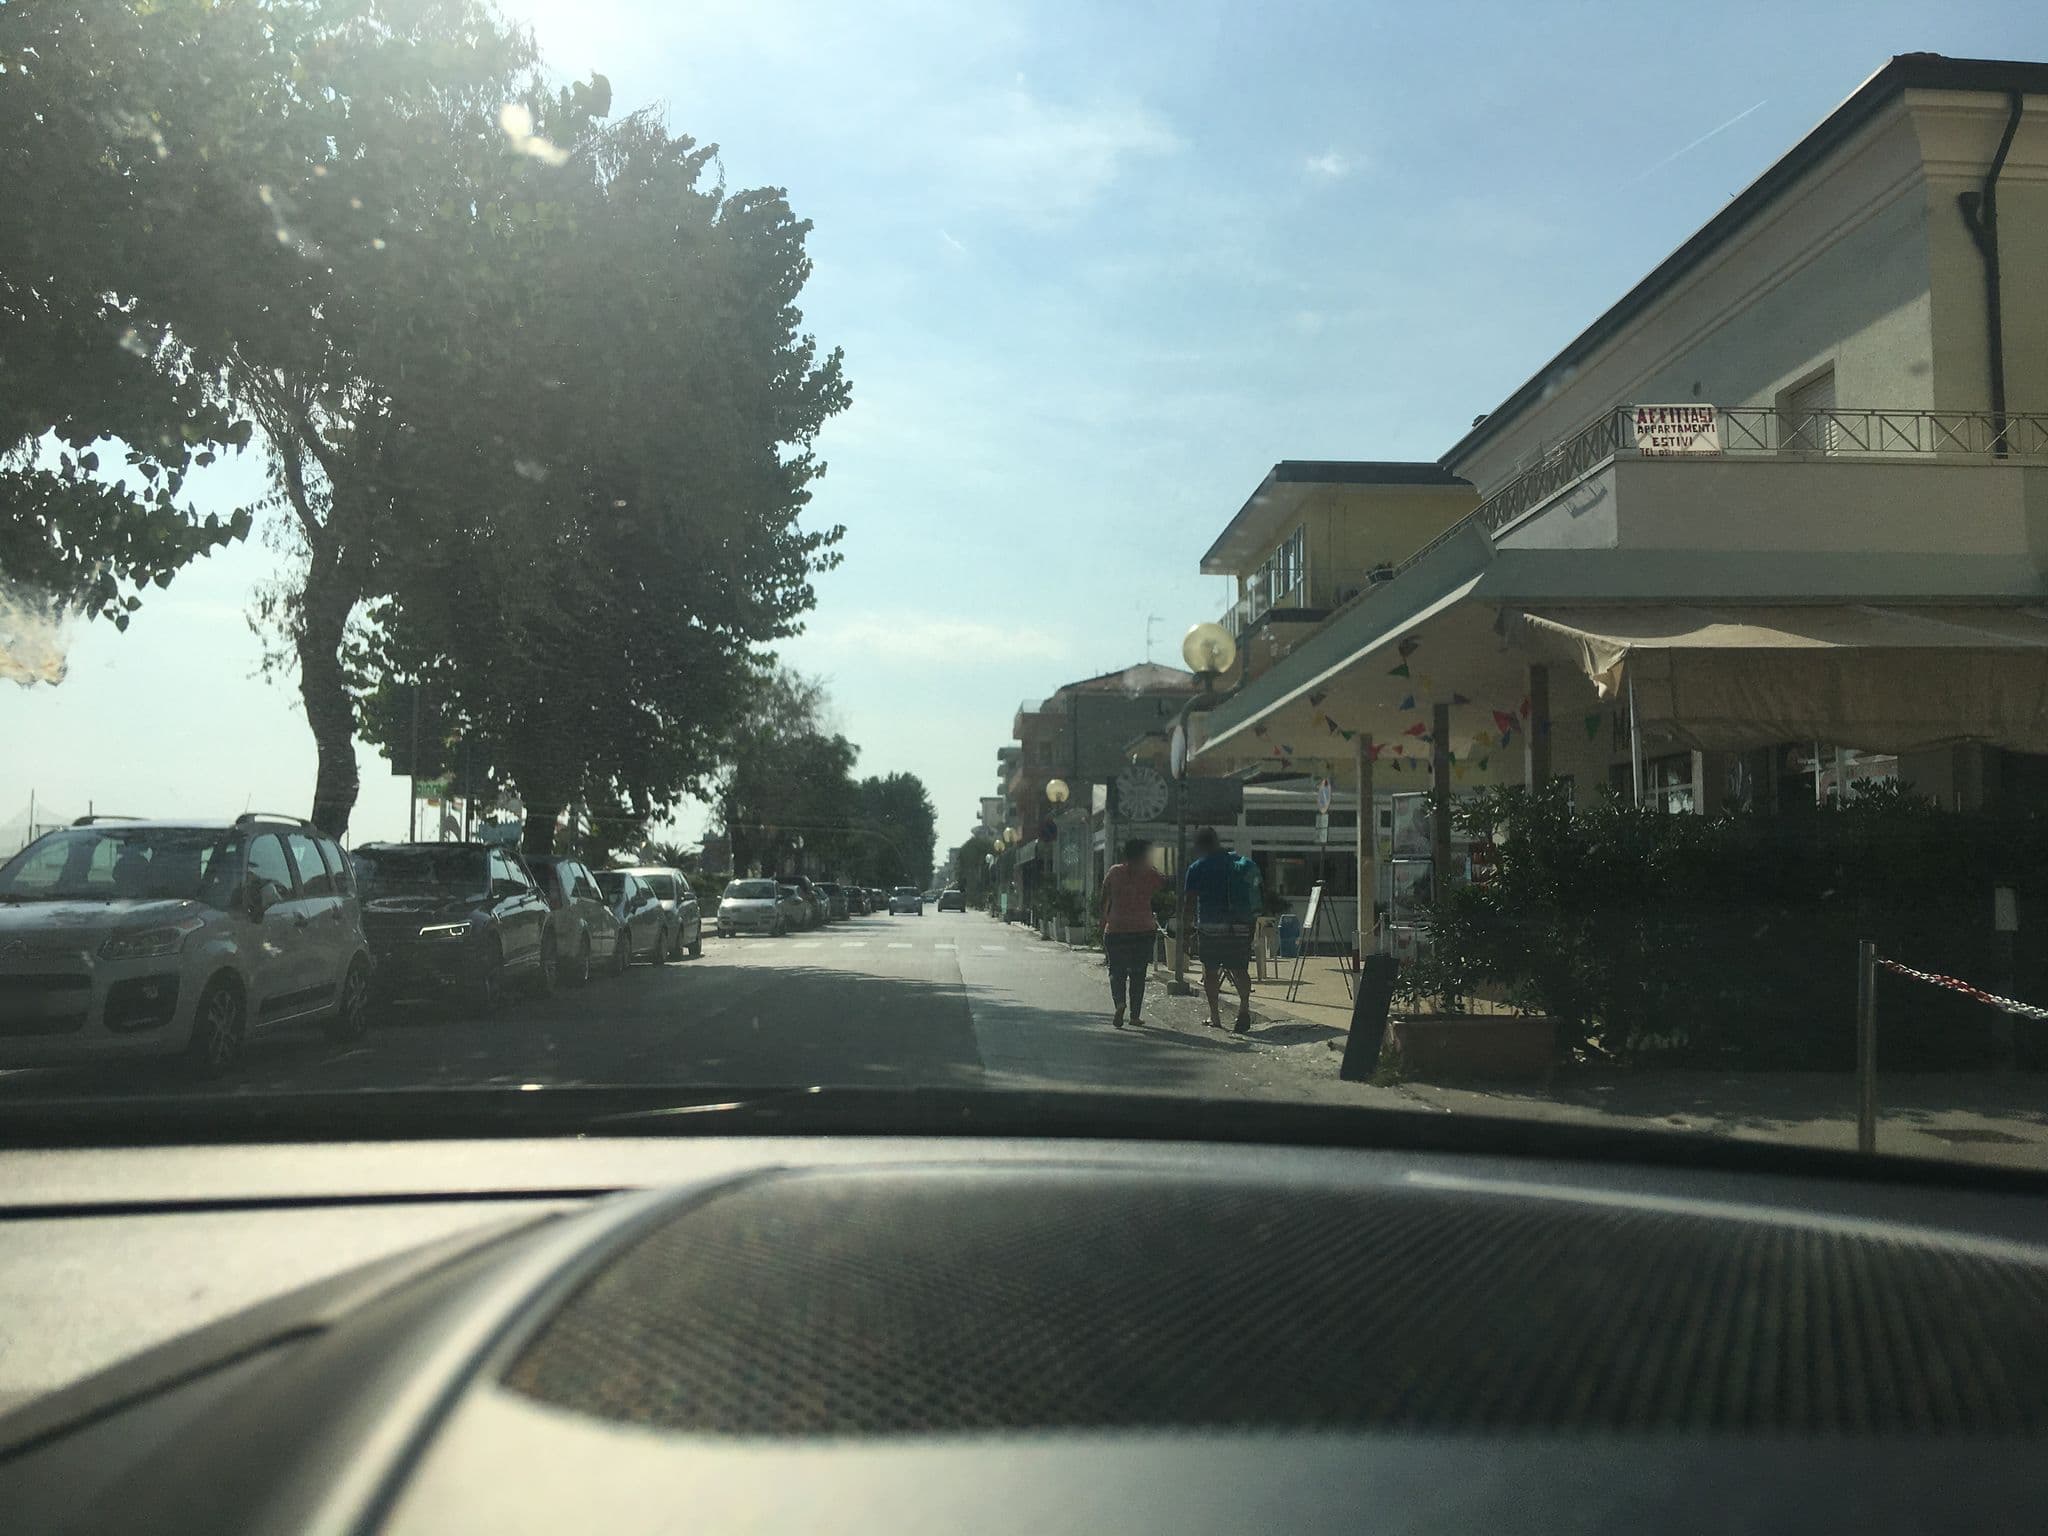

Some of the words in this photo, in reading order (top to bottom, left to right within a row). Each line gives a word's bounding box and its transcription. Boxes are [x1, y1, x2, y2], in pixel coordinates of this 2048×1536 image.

[1637, 407, 1713, 424] AFFITTASI
[1637, 424, 1715, 434] APPARTAMENTI
[1652, 436, 1693, 447] ESTIVI
